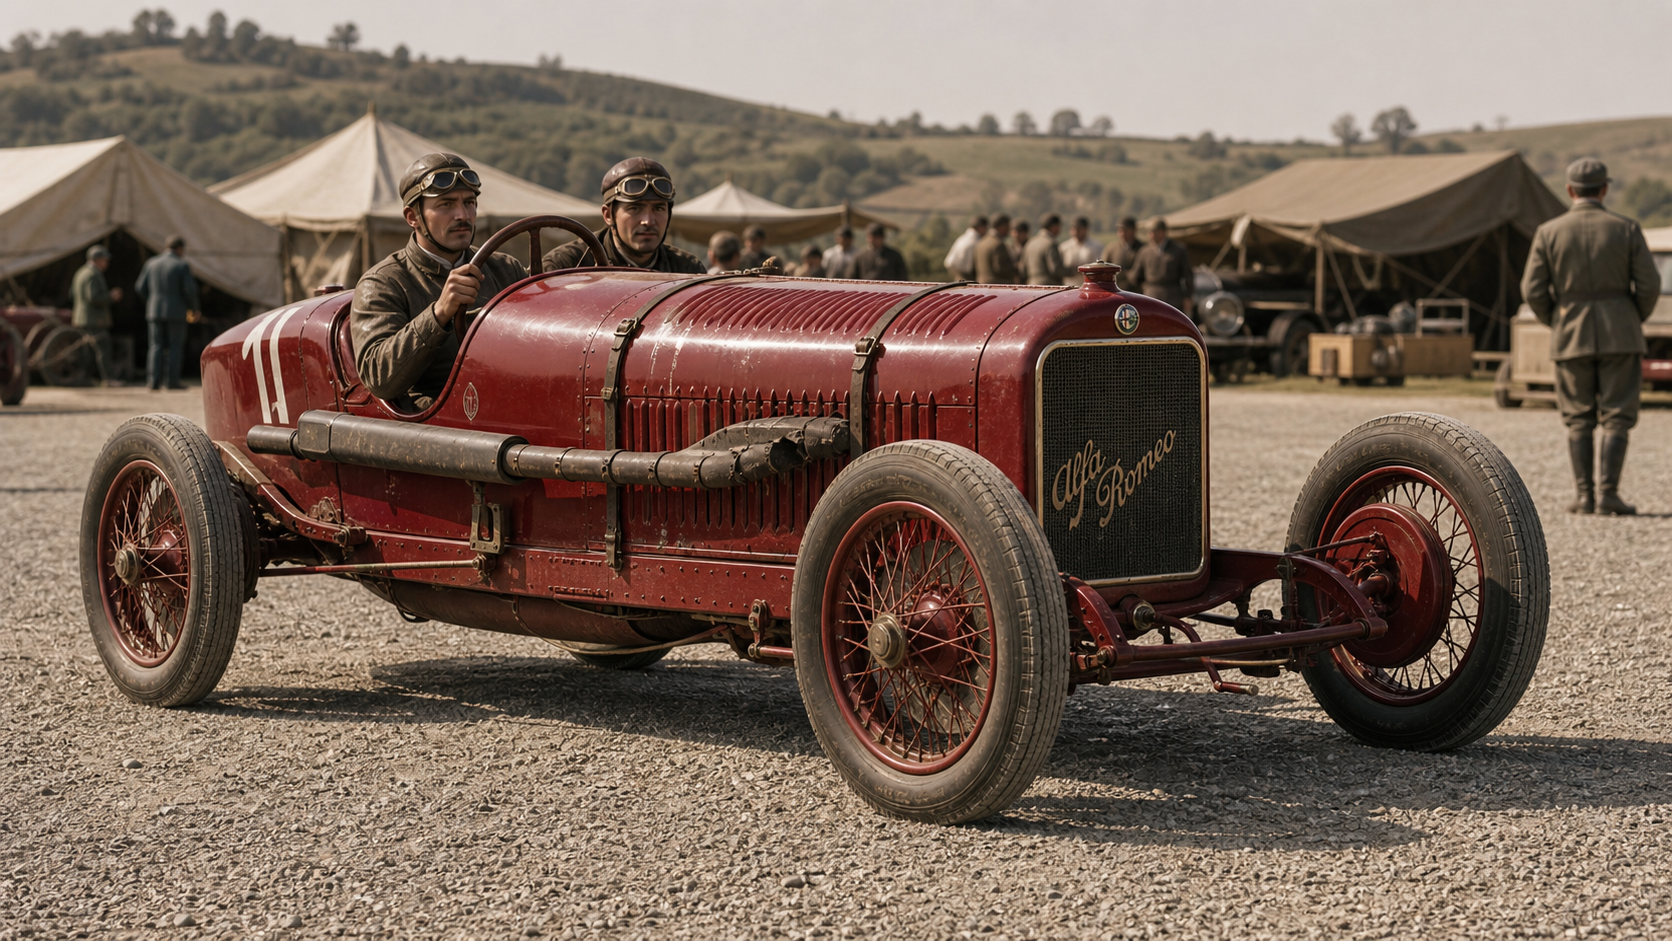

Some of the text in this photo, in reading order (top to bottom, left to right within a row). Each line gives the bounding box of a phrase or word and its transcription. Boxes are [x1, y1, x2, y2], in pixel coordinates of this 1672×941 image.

[241, 305, 304, 425] 11
[1052, 439, 1107, 531] Alfa
[1095, 429, 1177, 528] Romeo
